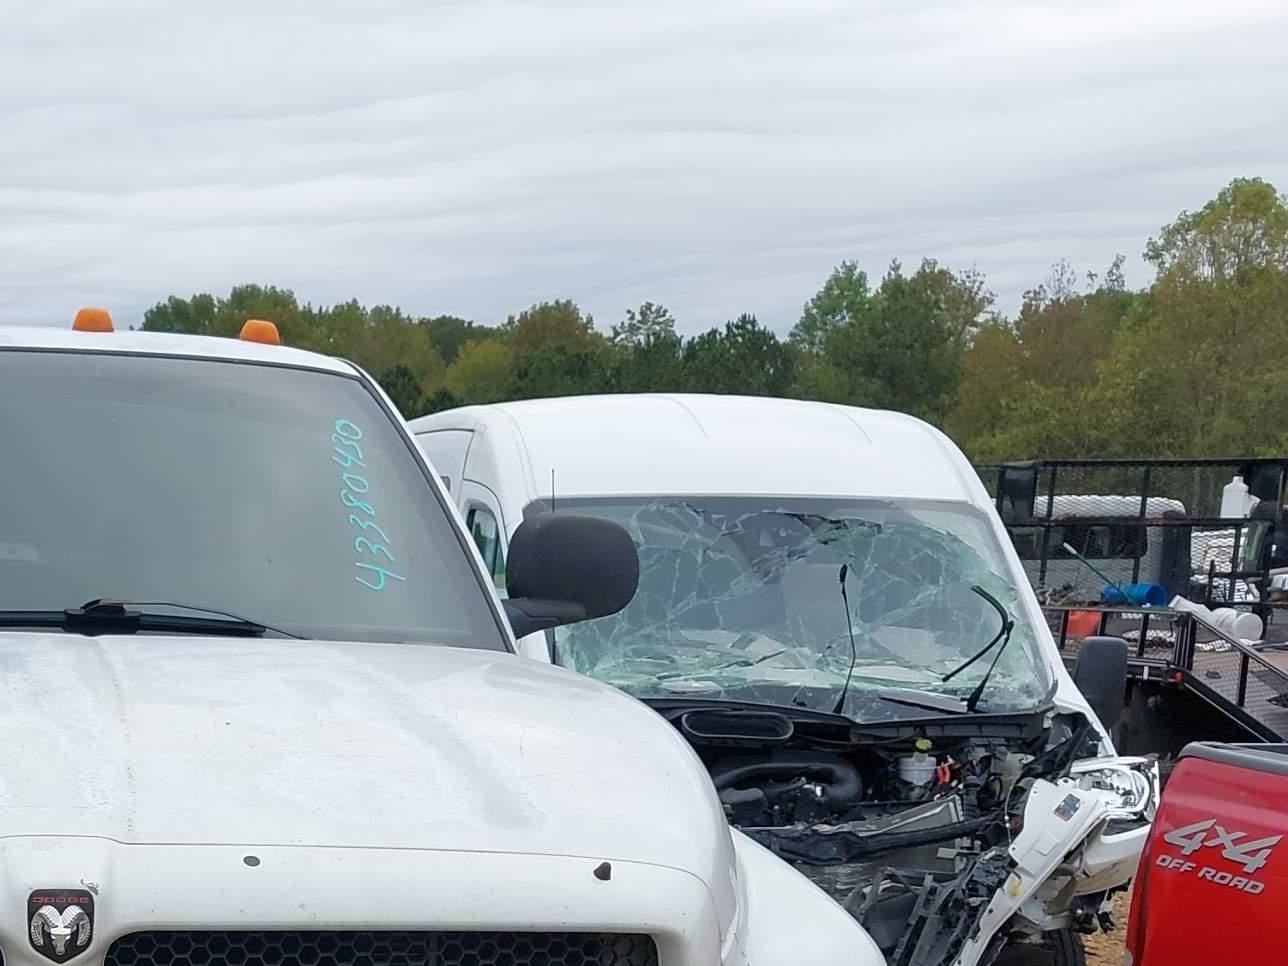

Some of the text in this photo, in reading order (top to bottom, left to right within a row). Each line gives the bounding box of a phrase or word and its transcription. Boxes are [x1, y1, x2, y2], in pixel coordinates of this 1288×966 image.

[331, 418, 407, 591] 43380430
[1155, 854, 1265, 895] OFF ROAD
[32, 896, 89, 904] DODGE
